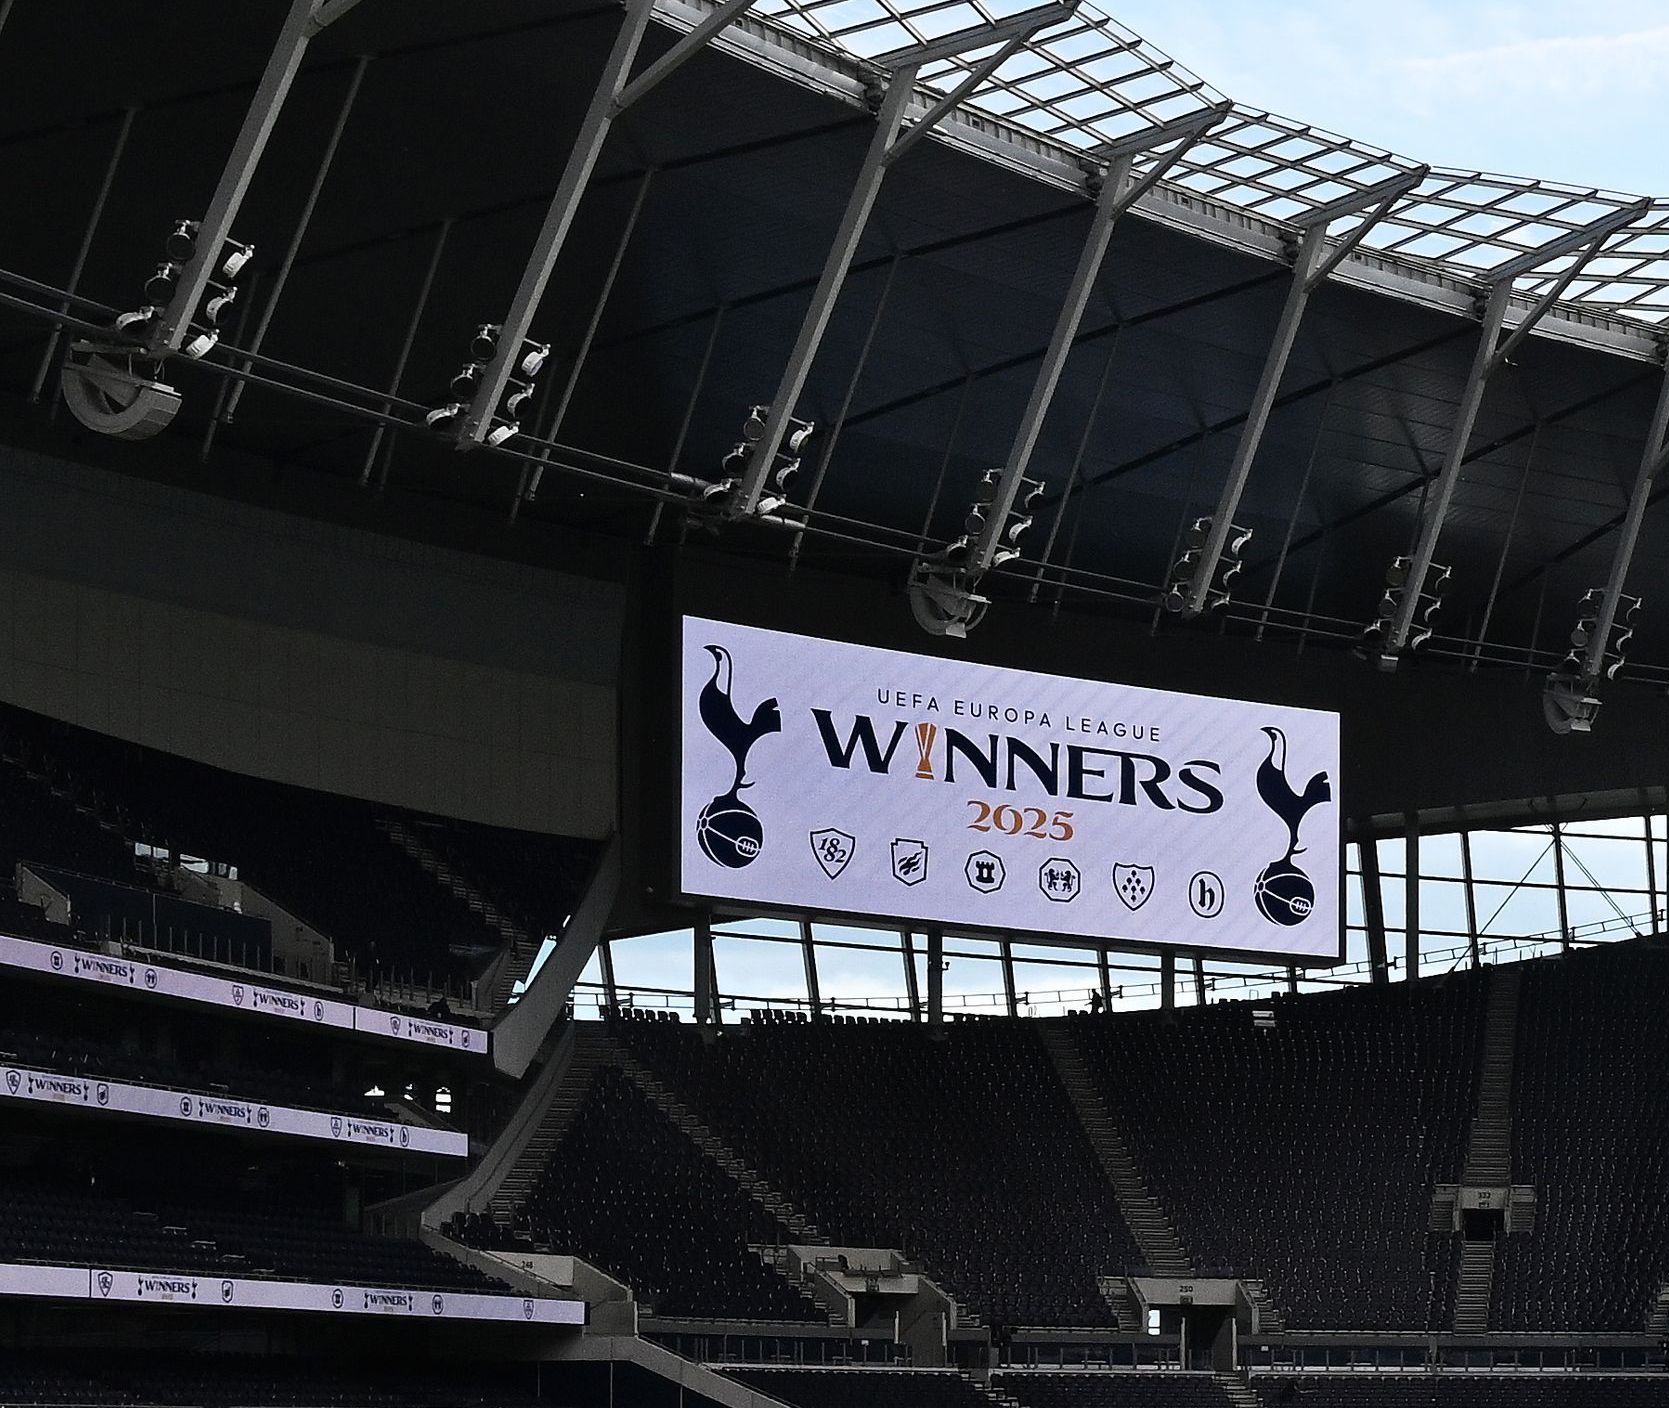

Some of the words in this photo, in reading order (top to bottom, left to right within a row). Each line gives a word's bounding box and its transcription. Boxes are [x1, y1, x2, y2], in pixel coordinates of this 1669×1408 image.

[877, 688, 940, 713] UEFA
[954, 699, 1051, 729] EUROPA
[1065, 715, 1161, 743] LEAGUE
[810, 707, 1224, 814] WINNERS
[966, 800, 1075, 842] 2025
